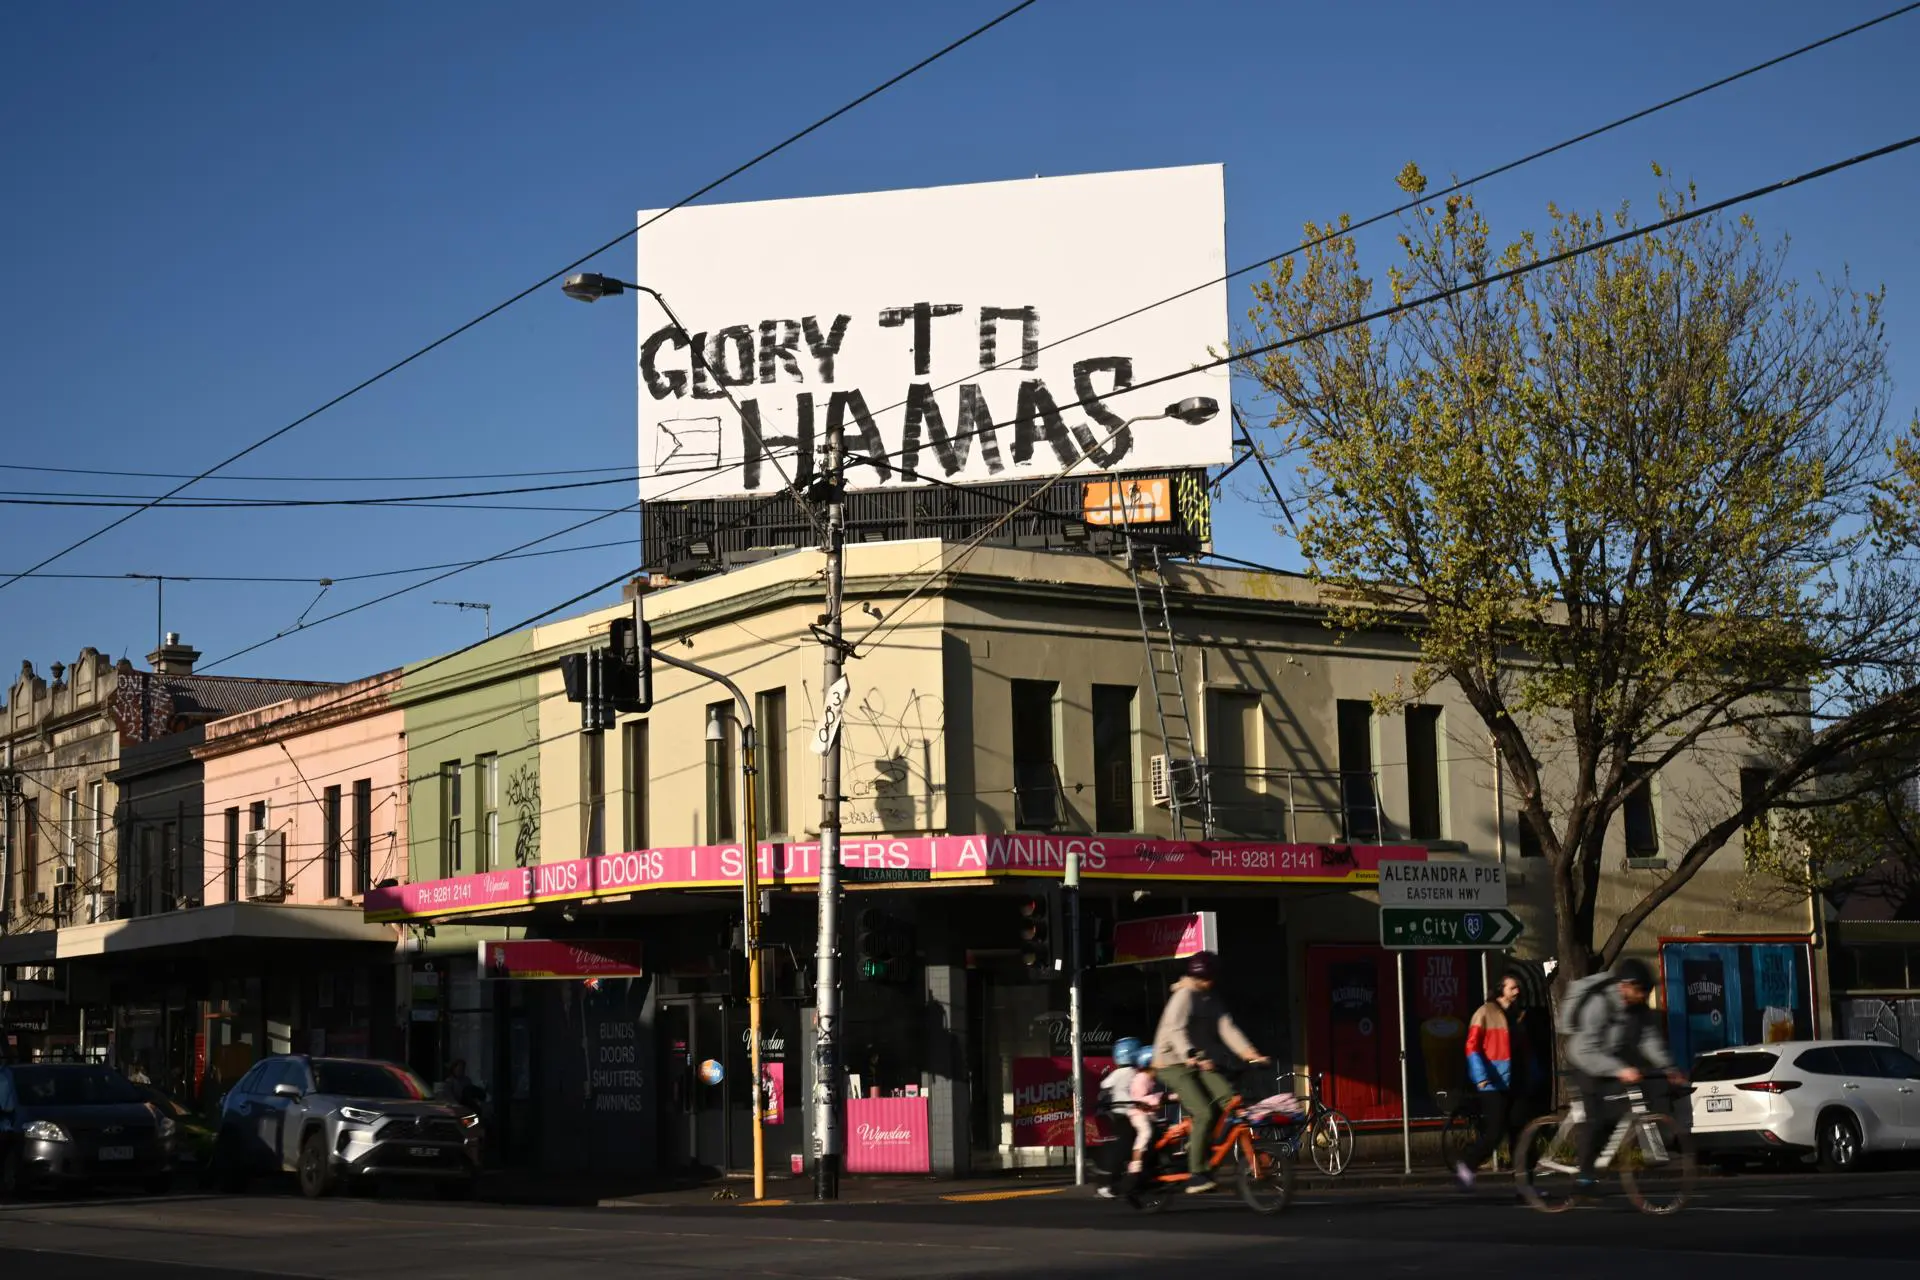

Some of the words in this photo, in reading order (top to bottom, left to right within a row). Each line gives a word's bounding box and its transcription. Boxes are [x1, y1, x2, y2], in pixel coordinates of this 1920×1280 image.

[639, 313, 852, 400] GLORY
[878, 301, 1041, 375] TO
[743, 356, 1134, 490] HAMAS
[522, 863, 577, 896] BLINDS
[600, 850, 664, 886] DOORS
[720, 841, 911, 877] SHUTERS
[956, 838, 1107, 869] AWNINGS
[1211, 850, 1237, 868] PH:
[1241, 850, 1276, 869] 9281
[1281, 852, 1316, 869] 2141
[912, 869, 930, 881] PDE
[1384, 865, 1468, 883] ALEXANDRA
[1475, 867, 1501, 884] PDE
[433, 887, 451, 903] 9281
[453, 883, 472, 901] 2141
[1407, 887, 1453, 900] EASTERN
[1459, 887, 1481, 900] HWY
[1422, 916, 1458, 940] City
[1467, 916, 1481, 934] 83
[1427, 955, 1454, 977] STAY
[1423, 976, 1459, 998] FUSSY
[600, 1021, 635, 1040] BLINDS
[600, 1046, 635, 1064] DOORS
[593, 1069, 644, 1088] SHUTTERS
[596, 1093, 643, 1112] AWNINGS
[1016, 1080, 1072, 1106] HURR
